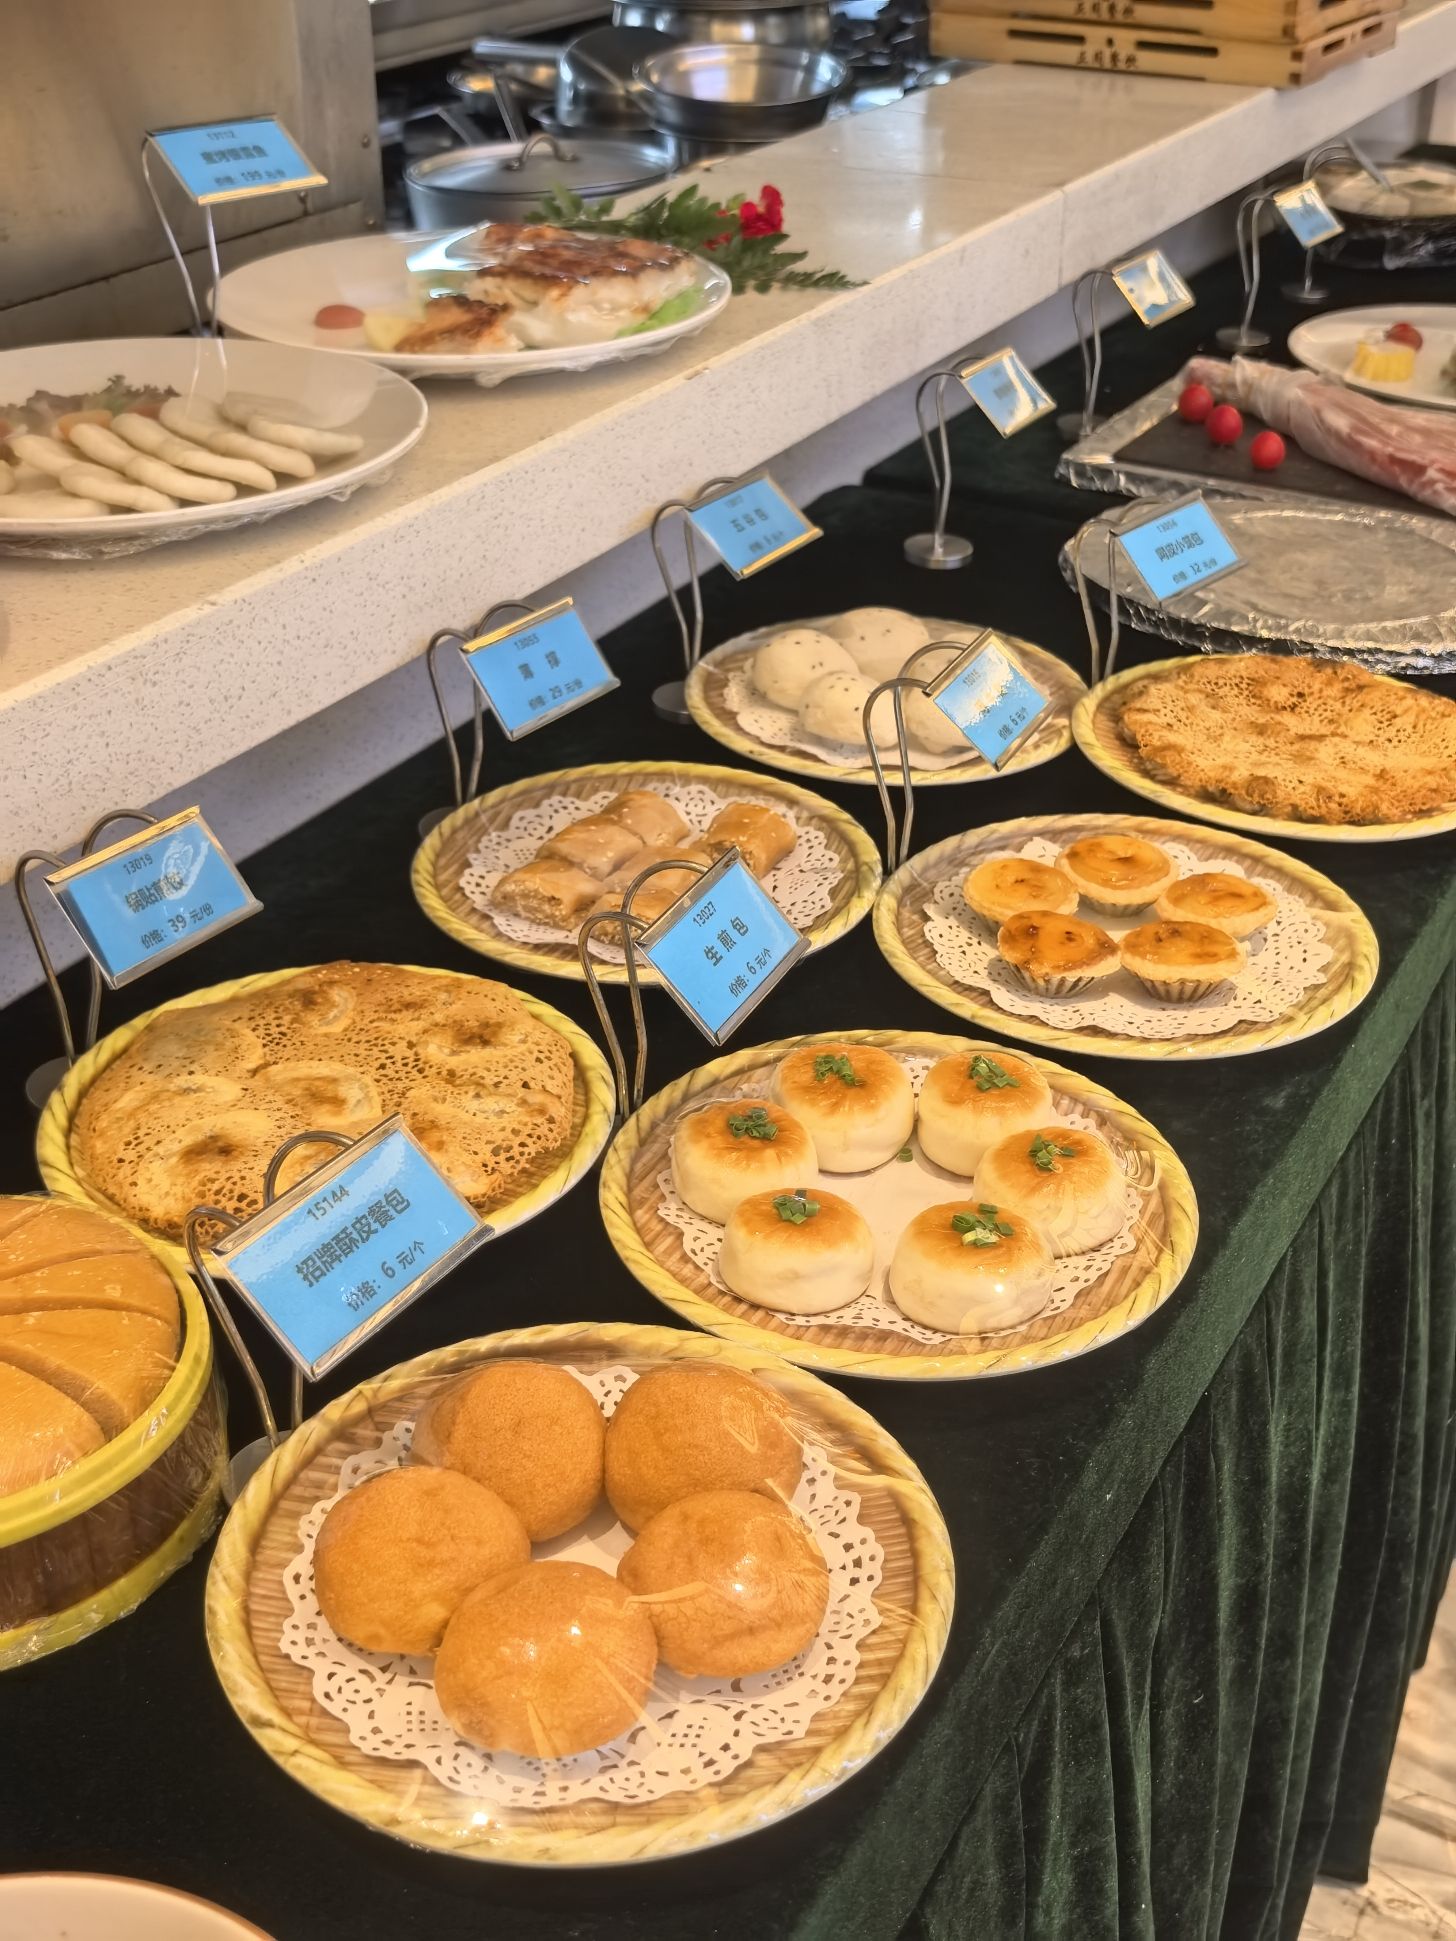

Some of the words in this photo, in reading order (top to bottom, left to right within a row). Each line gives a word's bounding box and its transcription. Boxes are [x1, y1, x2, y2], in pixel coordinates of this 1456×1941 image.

[122, 853, 154, 876] 13019
[167, 914, 188, 933] 39
[692, 901, 718, 928] 13027
[702, 915, 750, 967] 生煎包
[745, 961, 757, 976] 6
[754, 947, 773, 970] 元/个
[306, 1183, 351, 1222] 15144
[294, 1186, 412, 1288] 招牌酥皮餐包
[380, 1261, 397, 1280] 6
[395, 1239, 428, 1270] 元/个
